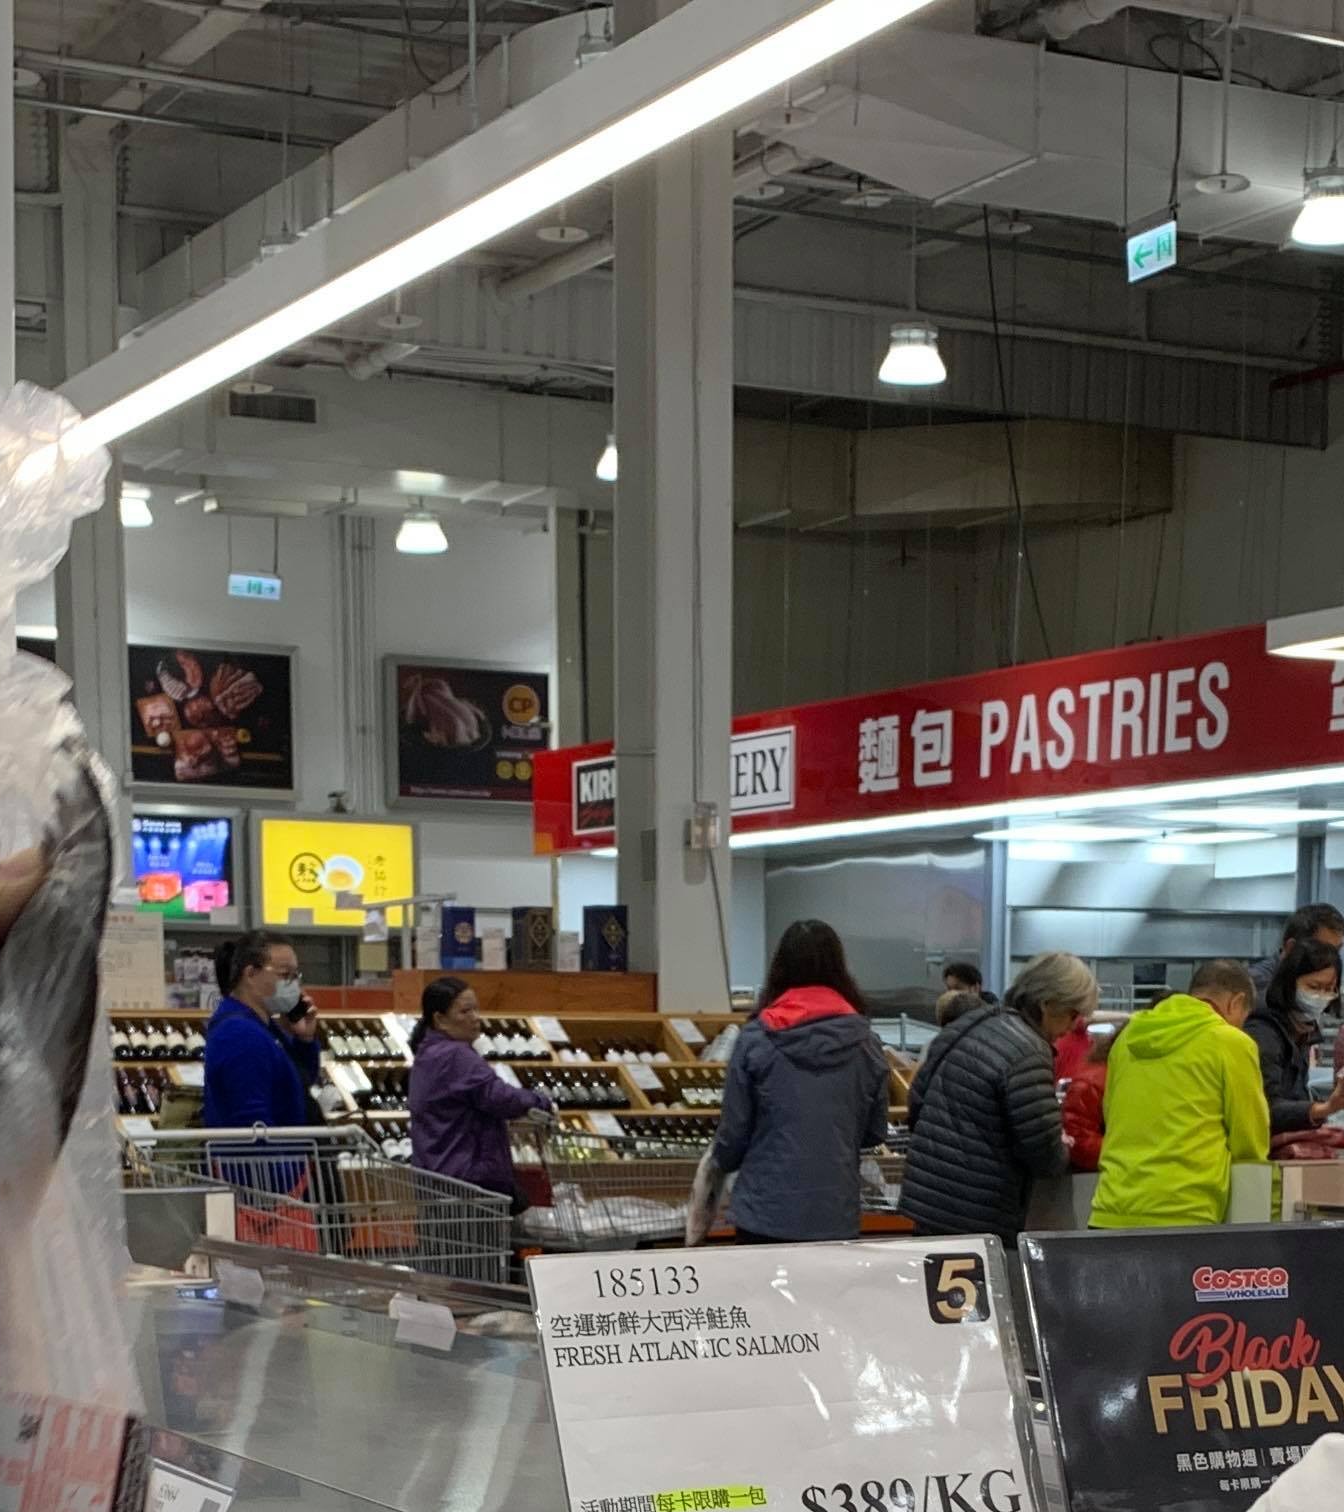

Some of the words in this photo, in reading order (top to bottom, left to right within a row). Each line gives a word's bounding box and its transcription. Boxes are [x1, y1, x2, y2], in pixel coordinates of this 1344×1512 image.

[980, 661, 1230, 778] PASTRIES
[859, 709, 953, 794] 麵包
[592, 1265, 700, 1298] 185133
[936, 1259, 978, 1318] 5
[1193, 1267, 1288, 1290] COSTCO
[1225, 1288, 1287, 1299] WHOLESALE
[550, 1305, 751, 1339] 空運新鮮大西洋鮭魚
[553, 1344, 622, 1368] FRESH
[736, 1332, 821, 1356] SALMON
[1169, 1312, 1321, 1388] Black
[1176, 1448, 1258, 1472] 黑色購物週
